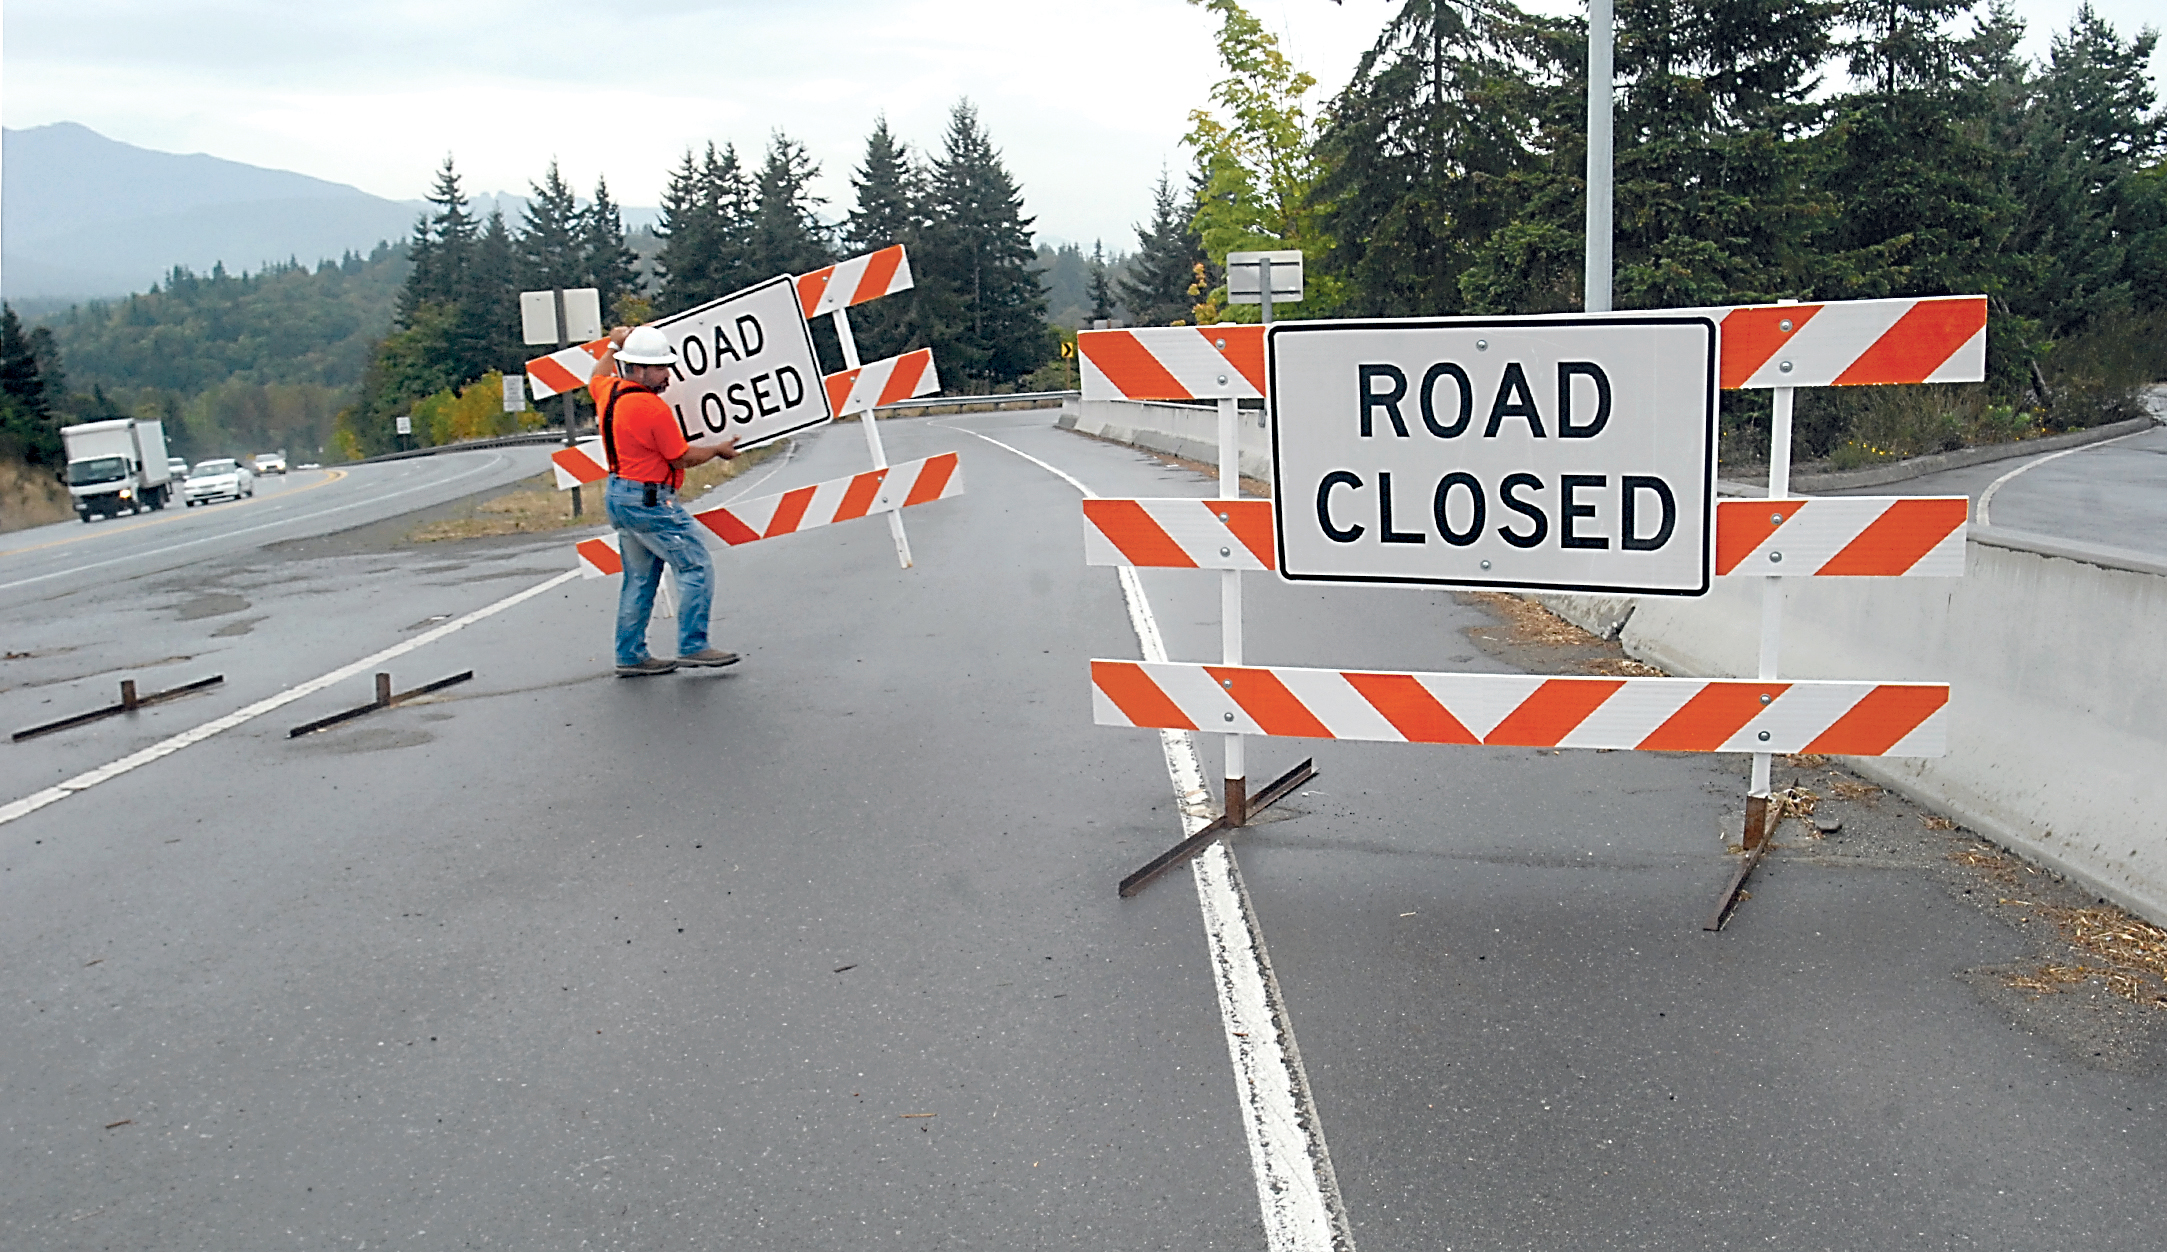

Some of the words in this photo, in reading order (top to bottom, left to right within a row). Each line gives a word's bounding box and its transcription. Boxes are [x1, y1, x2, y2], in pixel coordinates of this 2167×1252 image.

[674, 365, 804, 443] LOSED
[1358, 361, 1612, 440] ROAD
[1316, 470, 1676, 552] CLOSED
